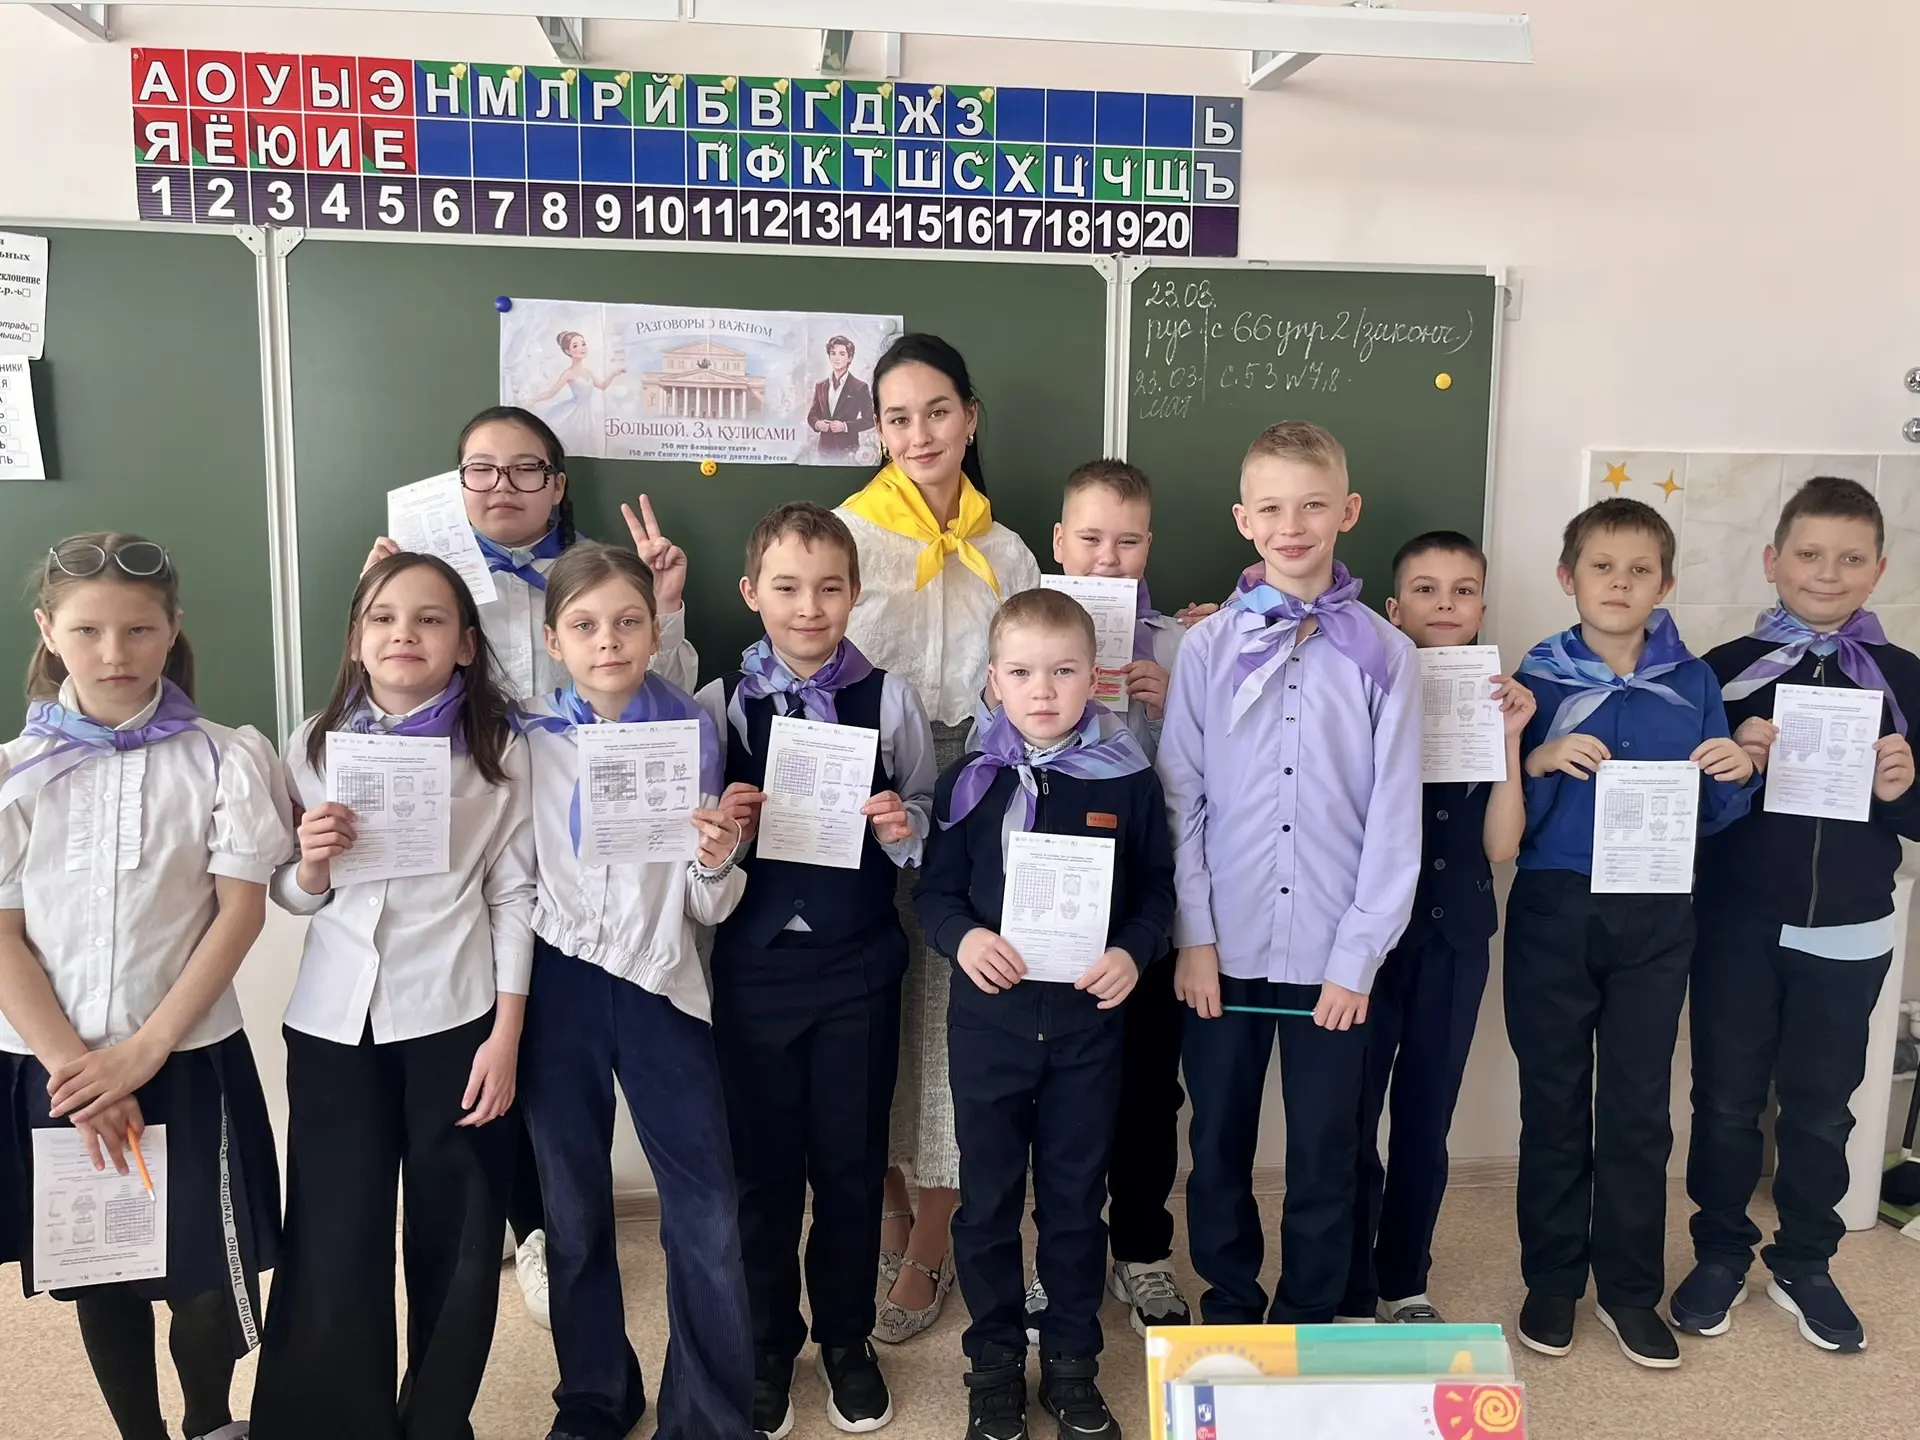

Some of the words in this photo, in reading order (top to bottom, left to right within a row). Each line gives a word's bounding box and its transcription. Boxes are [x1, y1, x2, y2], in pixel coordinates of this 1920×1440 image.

[138, 61, 177, 102] А
[195, 62, 238, 102] О
[254, 64, 293, 106] У
[311, 67, 349, 107] Ы
[368, 69, 405, 111] Э
[426, 77, 461, 115] Н
[480, 78, 517, 117] М
[535, 79, 570, 119] Л
[592, 82, 624, 122] Р
[644, 73, 677, 124] Й
[696, 86, 731, 126] Б
[749, 88, 784, 128] В
[803, 91, 831, 130] Г
[849, 93, 887, 135] Д
[897, 94, 943, 135] Ж
[954, 96, 985, 137] З
[1204, 106, 1236, 146] Ь
[143, 121, 180, 163] Я
[205, 113, 235, 164] Ё
[257, 125, 297, 167] Ю
[316, 127, 352, 169] И
[374, 129, 407, 171] Е
[696, 142, 729, 182] П
[745, 143, 787, 183] Ф
[802, 145, 833, 185] К
[853, 147, 885, 188] Т
[897, 148, 941, 188] Ш
[952, 150, 986, 191] С
[1002, 153, 1038, 193] Х
[1052, 155, 1086, 197] Ц
[1102, 158, 1132, 197] Ч
[1144, 158, 1191, 201] Щ
[1196, 162, 1236, 200] Ъ
[150, 176, 173, 217] 1
[206, 177, 236, 218] 2
[266, 180, 295, 221] 3
[320, 183, 350, 223] 4
[377, 185, 405, 226] 5
[432, 187, 461, 228] 6
[487, 190, 516, 229] 7
[540, 191, 570, 232] 8
[595, 193, 623, 233] 9
[635, 195, 686, 236] 10
[695, 197, 734, 237] 11
[741, 198, 789, 238] 12
[792, 199, 841, 241] 13
[843, 200, 892, 242] 14
[894, 203, 943, 244] 15
[945, 204, 993, 246] 16
[996, 206, 1042, 246] 17
[1044, 207, 1091, 248] 18
[1094, 209, 1140, 249] 19
[1143, 210, 1191, 250] 20
[636, 318, 705, 334] РАЗГОВОРЫ
[719, 319, 773, 337] ВАЖНОМ
[693, 421, 713, 439] ЗА
[717, 425, 796, 441] КУЛИСАМИ
[222, 1173, 232, 1226] ORIGINAL
[227, 1236, 241, 1288] ORIGINAL
